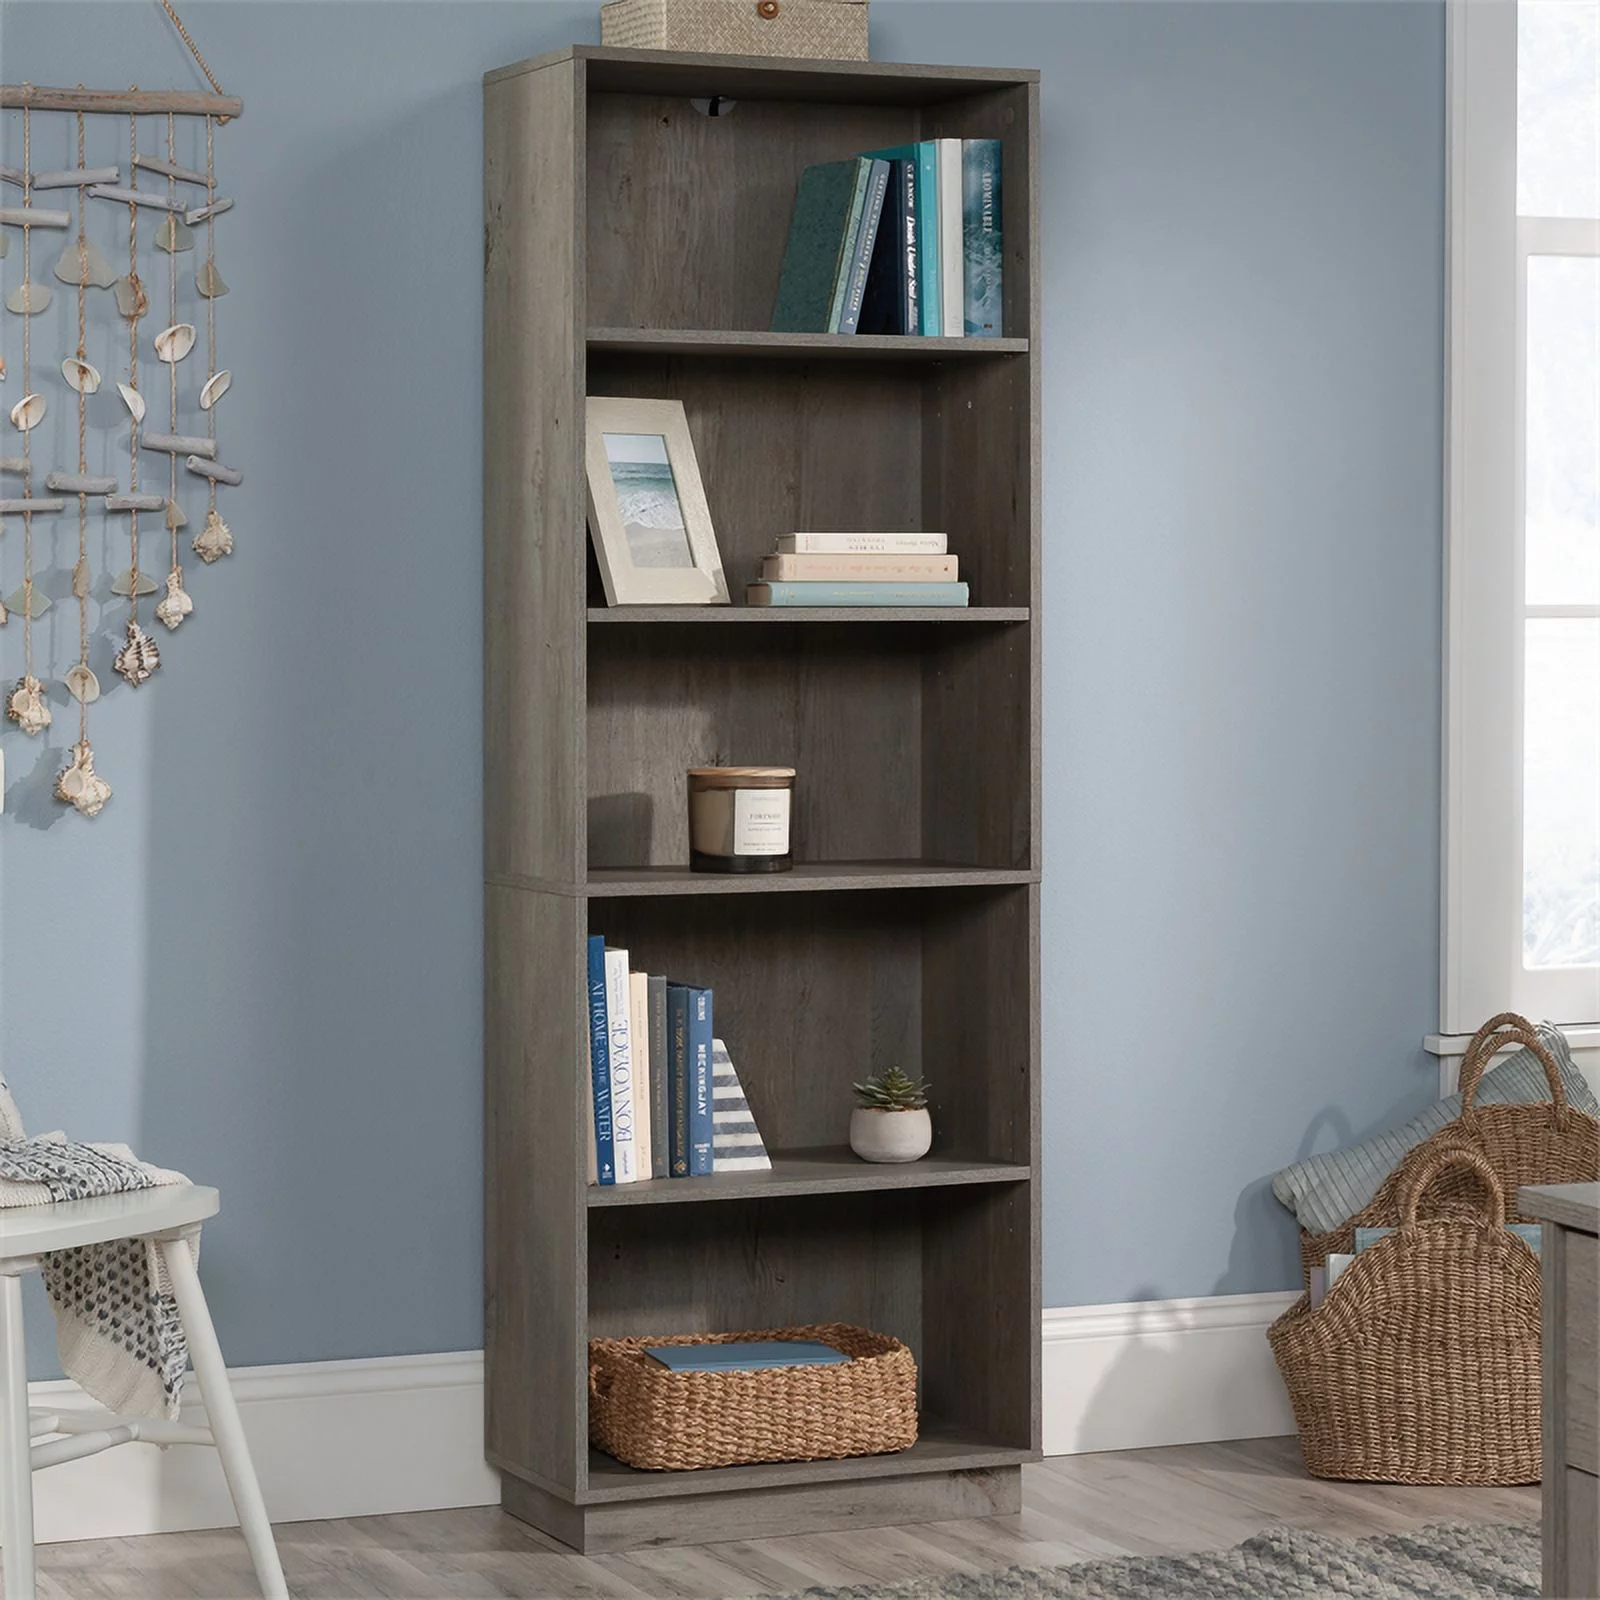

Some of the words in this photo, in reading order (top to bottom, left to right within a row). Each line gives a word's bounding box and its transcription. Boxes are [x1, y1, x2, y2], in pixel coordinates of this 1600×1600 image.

[906, 216, 916, 245] Death
[591, 979, 603, 1001] AT
[593, 1001, 607, 1047] HOME
[595, 1049, 606, 1064] ON
[610, 1020, 630, 1099] VOYAGE
[598, 1089, 612, 1142] WATER
[615, 1099, 632, 1143] BON
